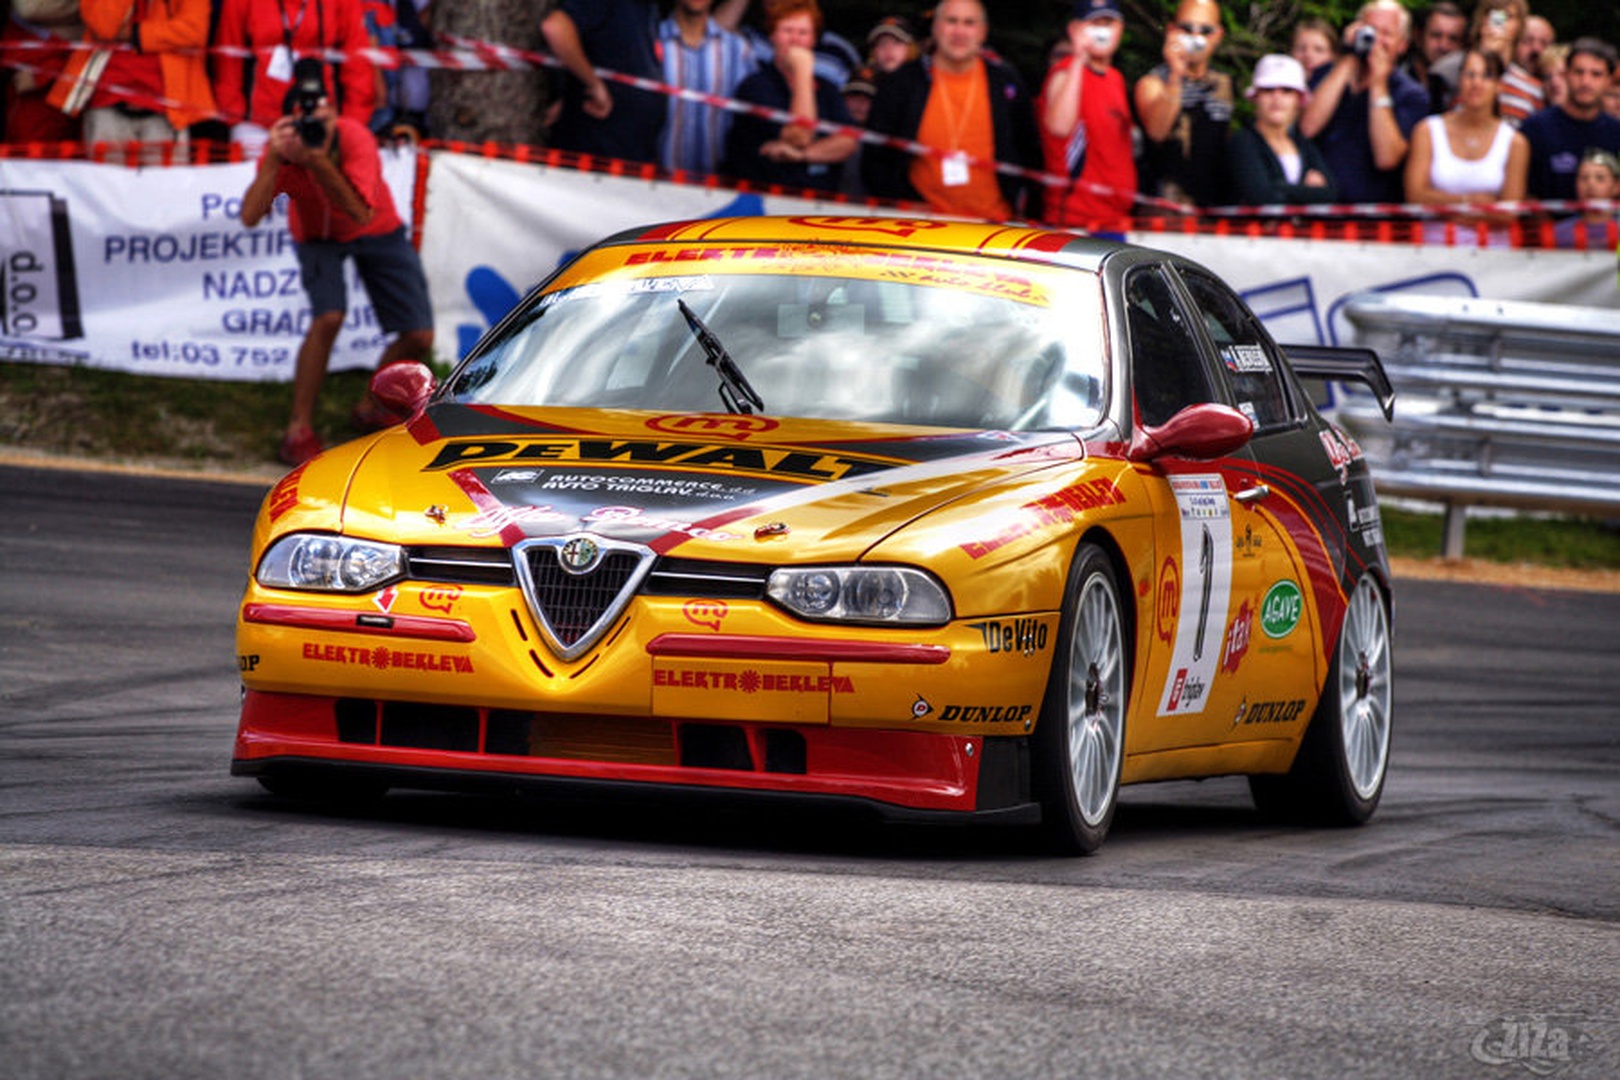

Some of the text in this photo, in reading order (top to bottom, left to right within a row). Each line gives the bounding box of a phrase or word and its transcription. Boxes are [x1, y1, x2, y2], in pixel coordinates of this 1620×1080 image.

[541, 481, 600, 491] AVTO
[1190, 521, 1215, 662] 1
[1263, 594, 1301, 625] AGAVE
[989, 618, 1048, 656] DeVito
[938, 704, 1032, 723] DUNLOP
[1244, 699, 1307, 725] DUNLOP
